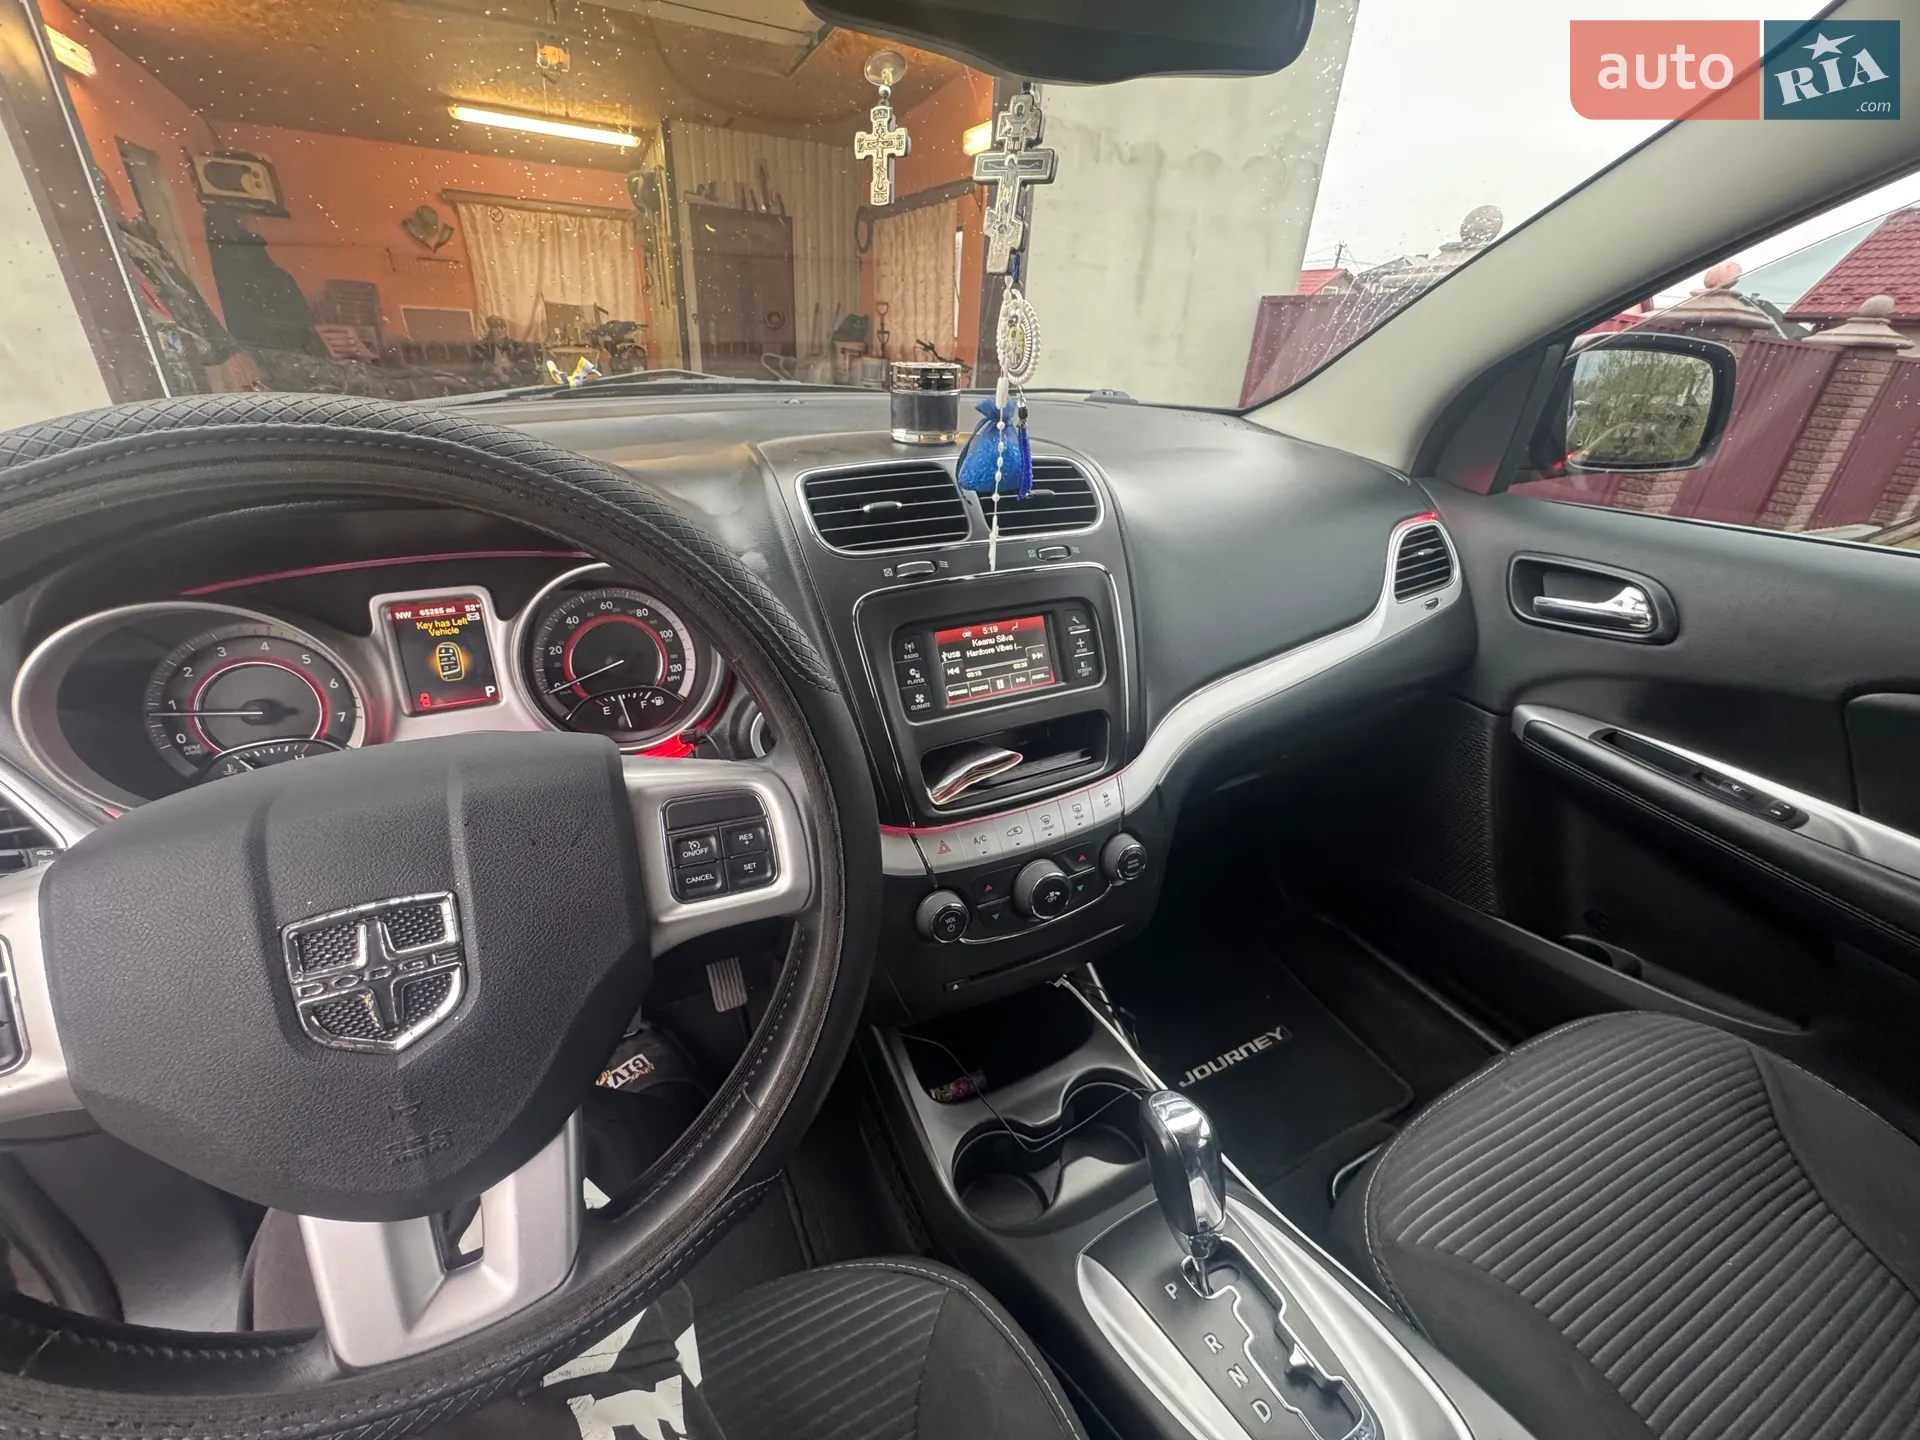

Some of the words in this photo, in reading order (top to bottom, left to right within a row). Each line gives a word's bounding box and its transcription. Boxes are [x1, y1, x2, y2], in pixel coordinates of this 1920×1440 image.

[600, 601, 613, 610] 60
[395, 611, 412, 619] NW
[636, 608, 649, 617] 80
[416, 621, 432, 630] Key
[435, 619, 450, 627] has
[452, 617, 468, 626] Left
[565, 616, 579, 625] 40
[429, 627, 459, 637] Vehicle
[659, 630, 673, 638] 100
[983, 626, 998, 635] 5:19
[972, 638, 995, 648] Keanu
[996, 634, 1013, 643] Silva
[260, 642, 270, 651] 4
[549, 646, 562, 655] 20
[966, 648, 995, 658] Hardcore
[995, 645, 1013, 653] Vibes
[217, 647, 227, 657] 3
[301, 654, 311, 664] 5
[183, 667, 193, 678] 2
[669, 664, 682, 673] 120
[329, 679, 338, 689] 6
[485, 686, 496, 697] P
[948, 689, 967, 697] browse
[168, 700, 176, 710] 1
[640, 701, 648, 709] F
[910, 702, 930, 710] CLIMATE
[603, 707, 611, 715] E
[337, 712, 346, 723] 7
[176, 733, 186, 745] 0
[739, 833, 753, 841] RES
[973, 835, 986, 845] A/C
[683, 847, 708, 858] ON/OFF
[743, 863, 756, 871] SET
[686, 874, 714, 884] CANCEL
[945, 916, 956, 924] VOL
[1178, 1027, 1283, 1088] JOURNEY
[1164, 1282, 1178, 1300] P
[1203, 1333, 1224, 1354] R
[1227, 1364, 1250, 1389] N
[1251, 1400, 1273, 1424] D
